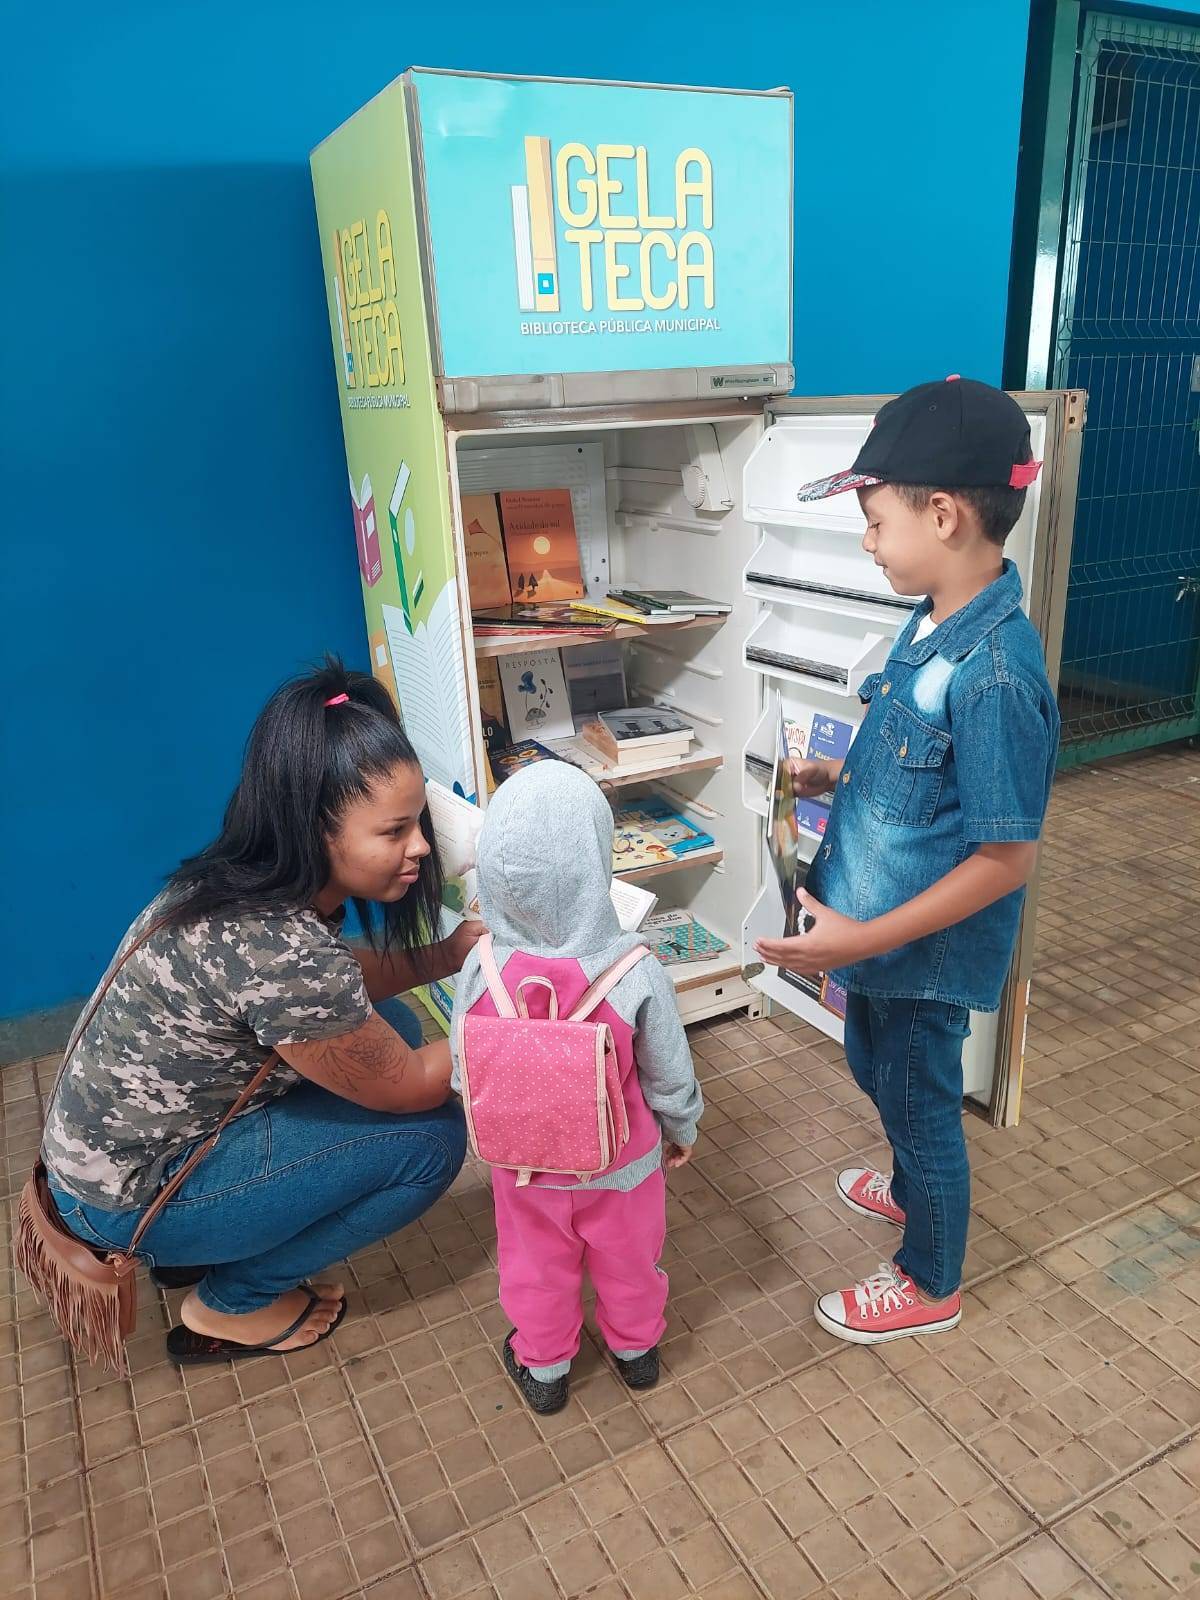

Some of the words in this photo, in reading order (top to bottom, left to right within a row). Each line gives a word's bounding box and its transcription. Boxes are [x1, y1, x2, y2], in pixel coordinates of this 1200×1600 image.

[556, 142, 714, 229] GELA
[341, 208, 397, 310] GELA
[564, 230, 715, 312] TECA
[350, 299, 406, 388] TECA
[520, 321, 597, 335] BIBLIOTECA
[599, 318, 652, 333] PÚBLICA
[655, 317, 721, 332] MUNICIPAL
[505, 656, 558, 669] RESPOSTA
